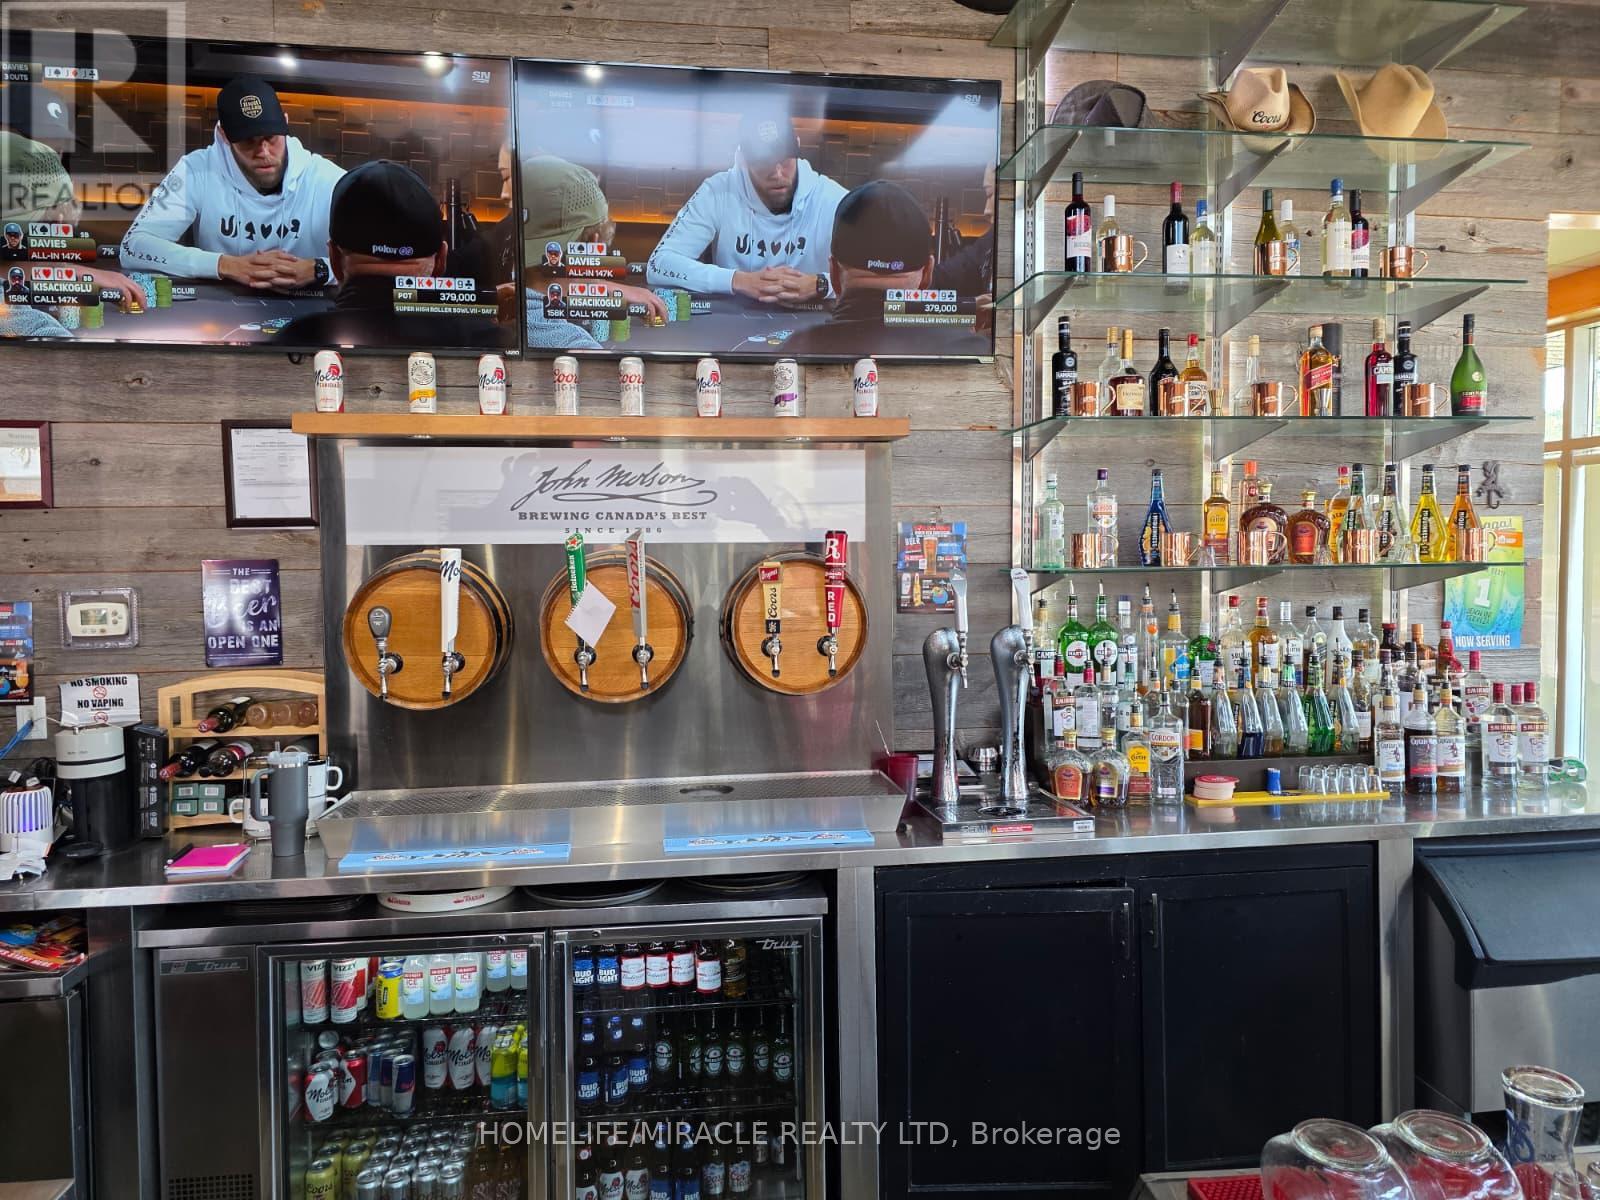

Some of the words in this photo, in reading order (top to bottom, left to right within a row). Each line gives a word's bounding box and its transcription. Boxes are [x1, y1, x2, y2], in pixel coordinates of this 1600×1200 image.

[1251, 110, 1282, 124] Coors
[30, 239, 67, 249] DAVIES
[101, 247, 115, 256] 7%
[31, 252, 60, 260] ALL-IN
[61, 252, 82, 261] 147K
[568, 257, 601, 265] DAVIES
[568, 269, 594, 277] ALL-IN
[595, 270, 613, 278] 147K
[631, 265, 643, 273] 7%
[33, 282, 92, 293] KISACIKOGLU
[102, 290, 121, 299] 93%
[440, 293, 477, 302] 379,000
[34, 296, 57, 304] CALL
[58, 296, 78, 304] 147K
[569, 299, 622, 308] KISACIKOGLU
[630, 305, 646, 314] 93%
[925, 304, 957, 313] 379,000
[569, 310, 589, 318] CALL
[510, 459, 592, 512] John
[518, 511, 590, 521] BREWING
[595, 511, 667, 521] CANADA'S
[672, 511, 708, 520] BEST
[232, 567, 251, 576] THE
[567, 554, 578, 592] Heineken
[767, 587, 778, 619] Coors
[827, 591, 837, 622] RED
[259, 619, 278, 632] AN
[207, 635, 246, 649] OPEN
[251, 634, 279, 648] ONE
[1455, 636, 1475, 648] NOW
[1476, 635, 1511, 647] SERVING
[70, 679, 83, 687] NO
[85, 676, 128, 687] SMOKING
[77, 699, 90, 709] NO
[91, 698, 124, 708] VAPING
[575, 970, 592, 978] BUD
[599, 969, 616, 977] BUD
[580, 1082, 598, 1091] BUD
[578, 1087, 600, 1098] LIGHT
